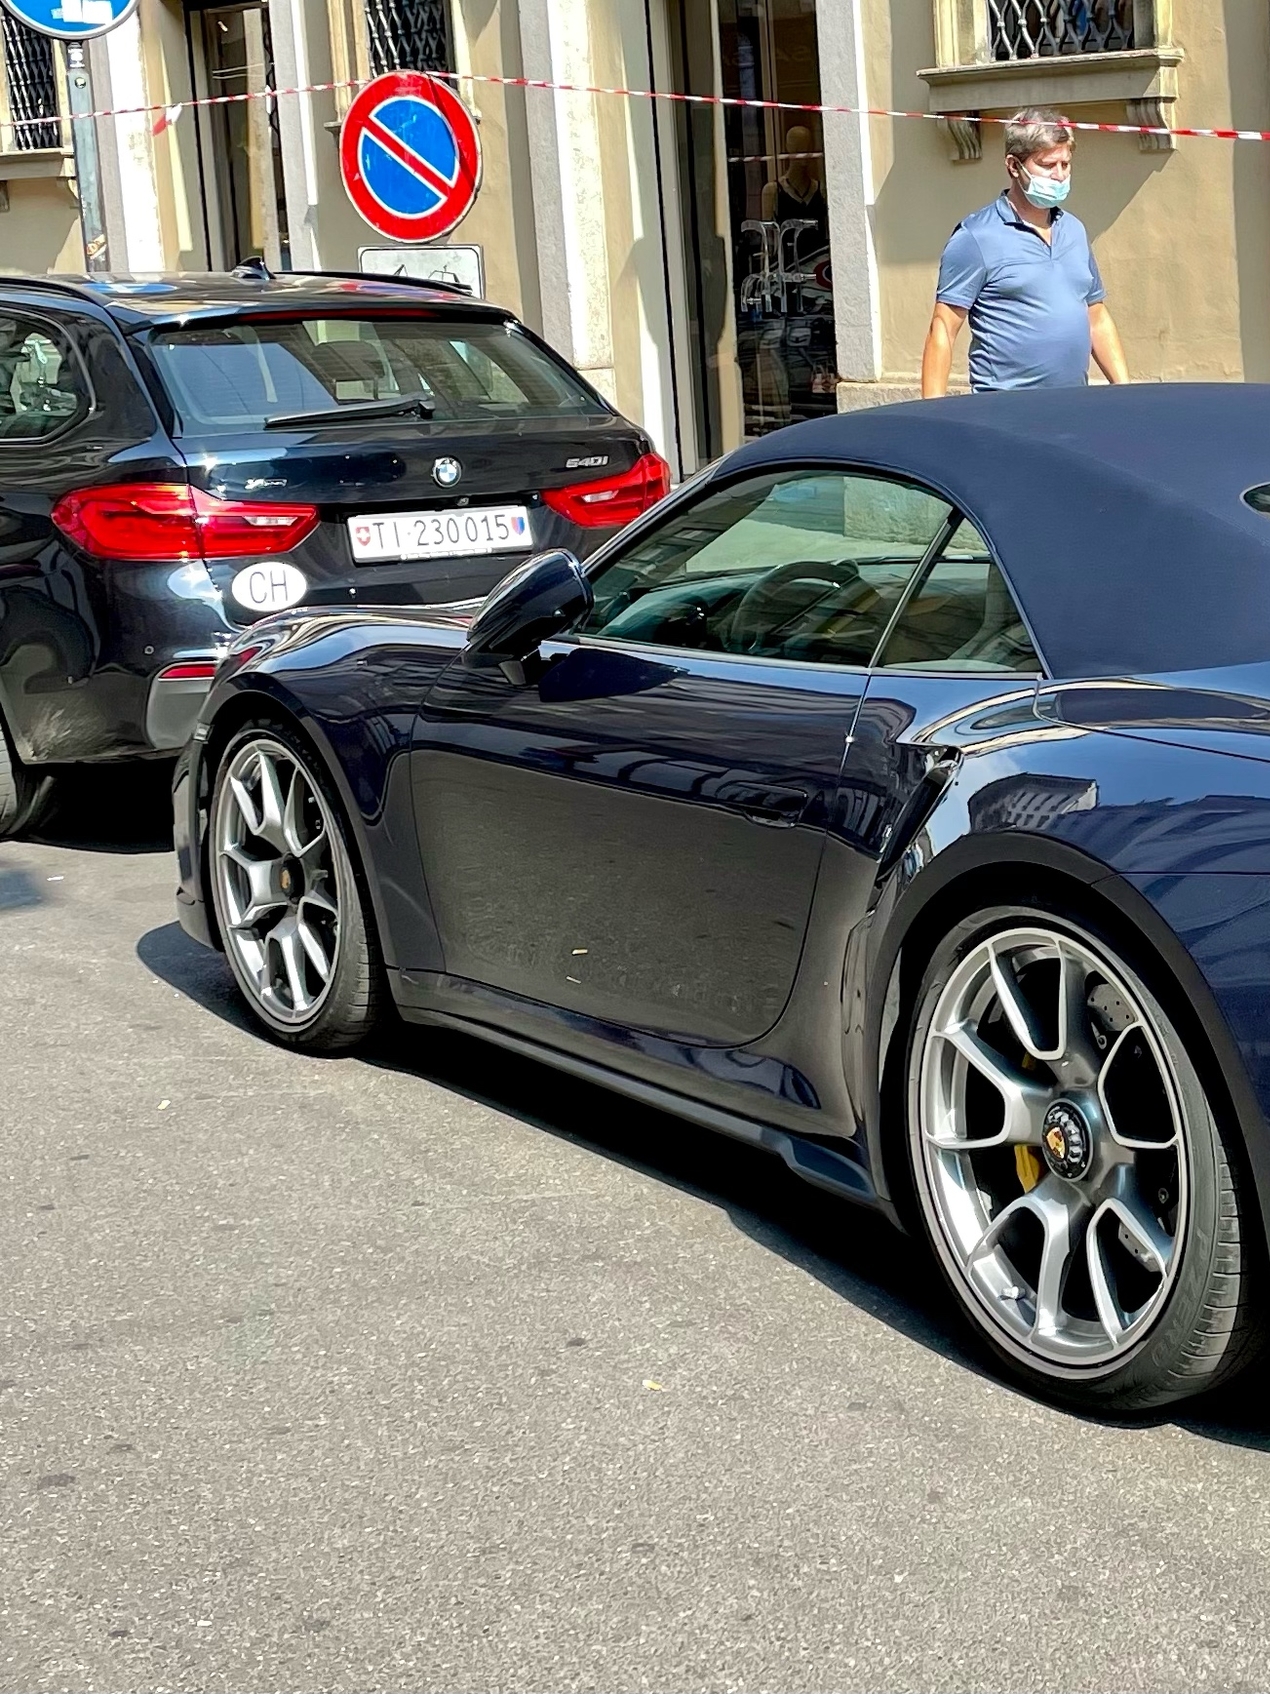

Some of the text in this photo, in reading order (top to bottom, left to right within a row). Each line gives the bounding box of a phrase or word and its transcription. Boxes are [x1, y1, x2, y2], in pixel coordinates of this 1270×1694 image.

[372, 513, 510, 550] TI 230015
[249, 569, 289, 604] CH
